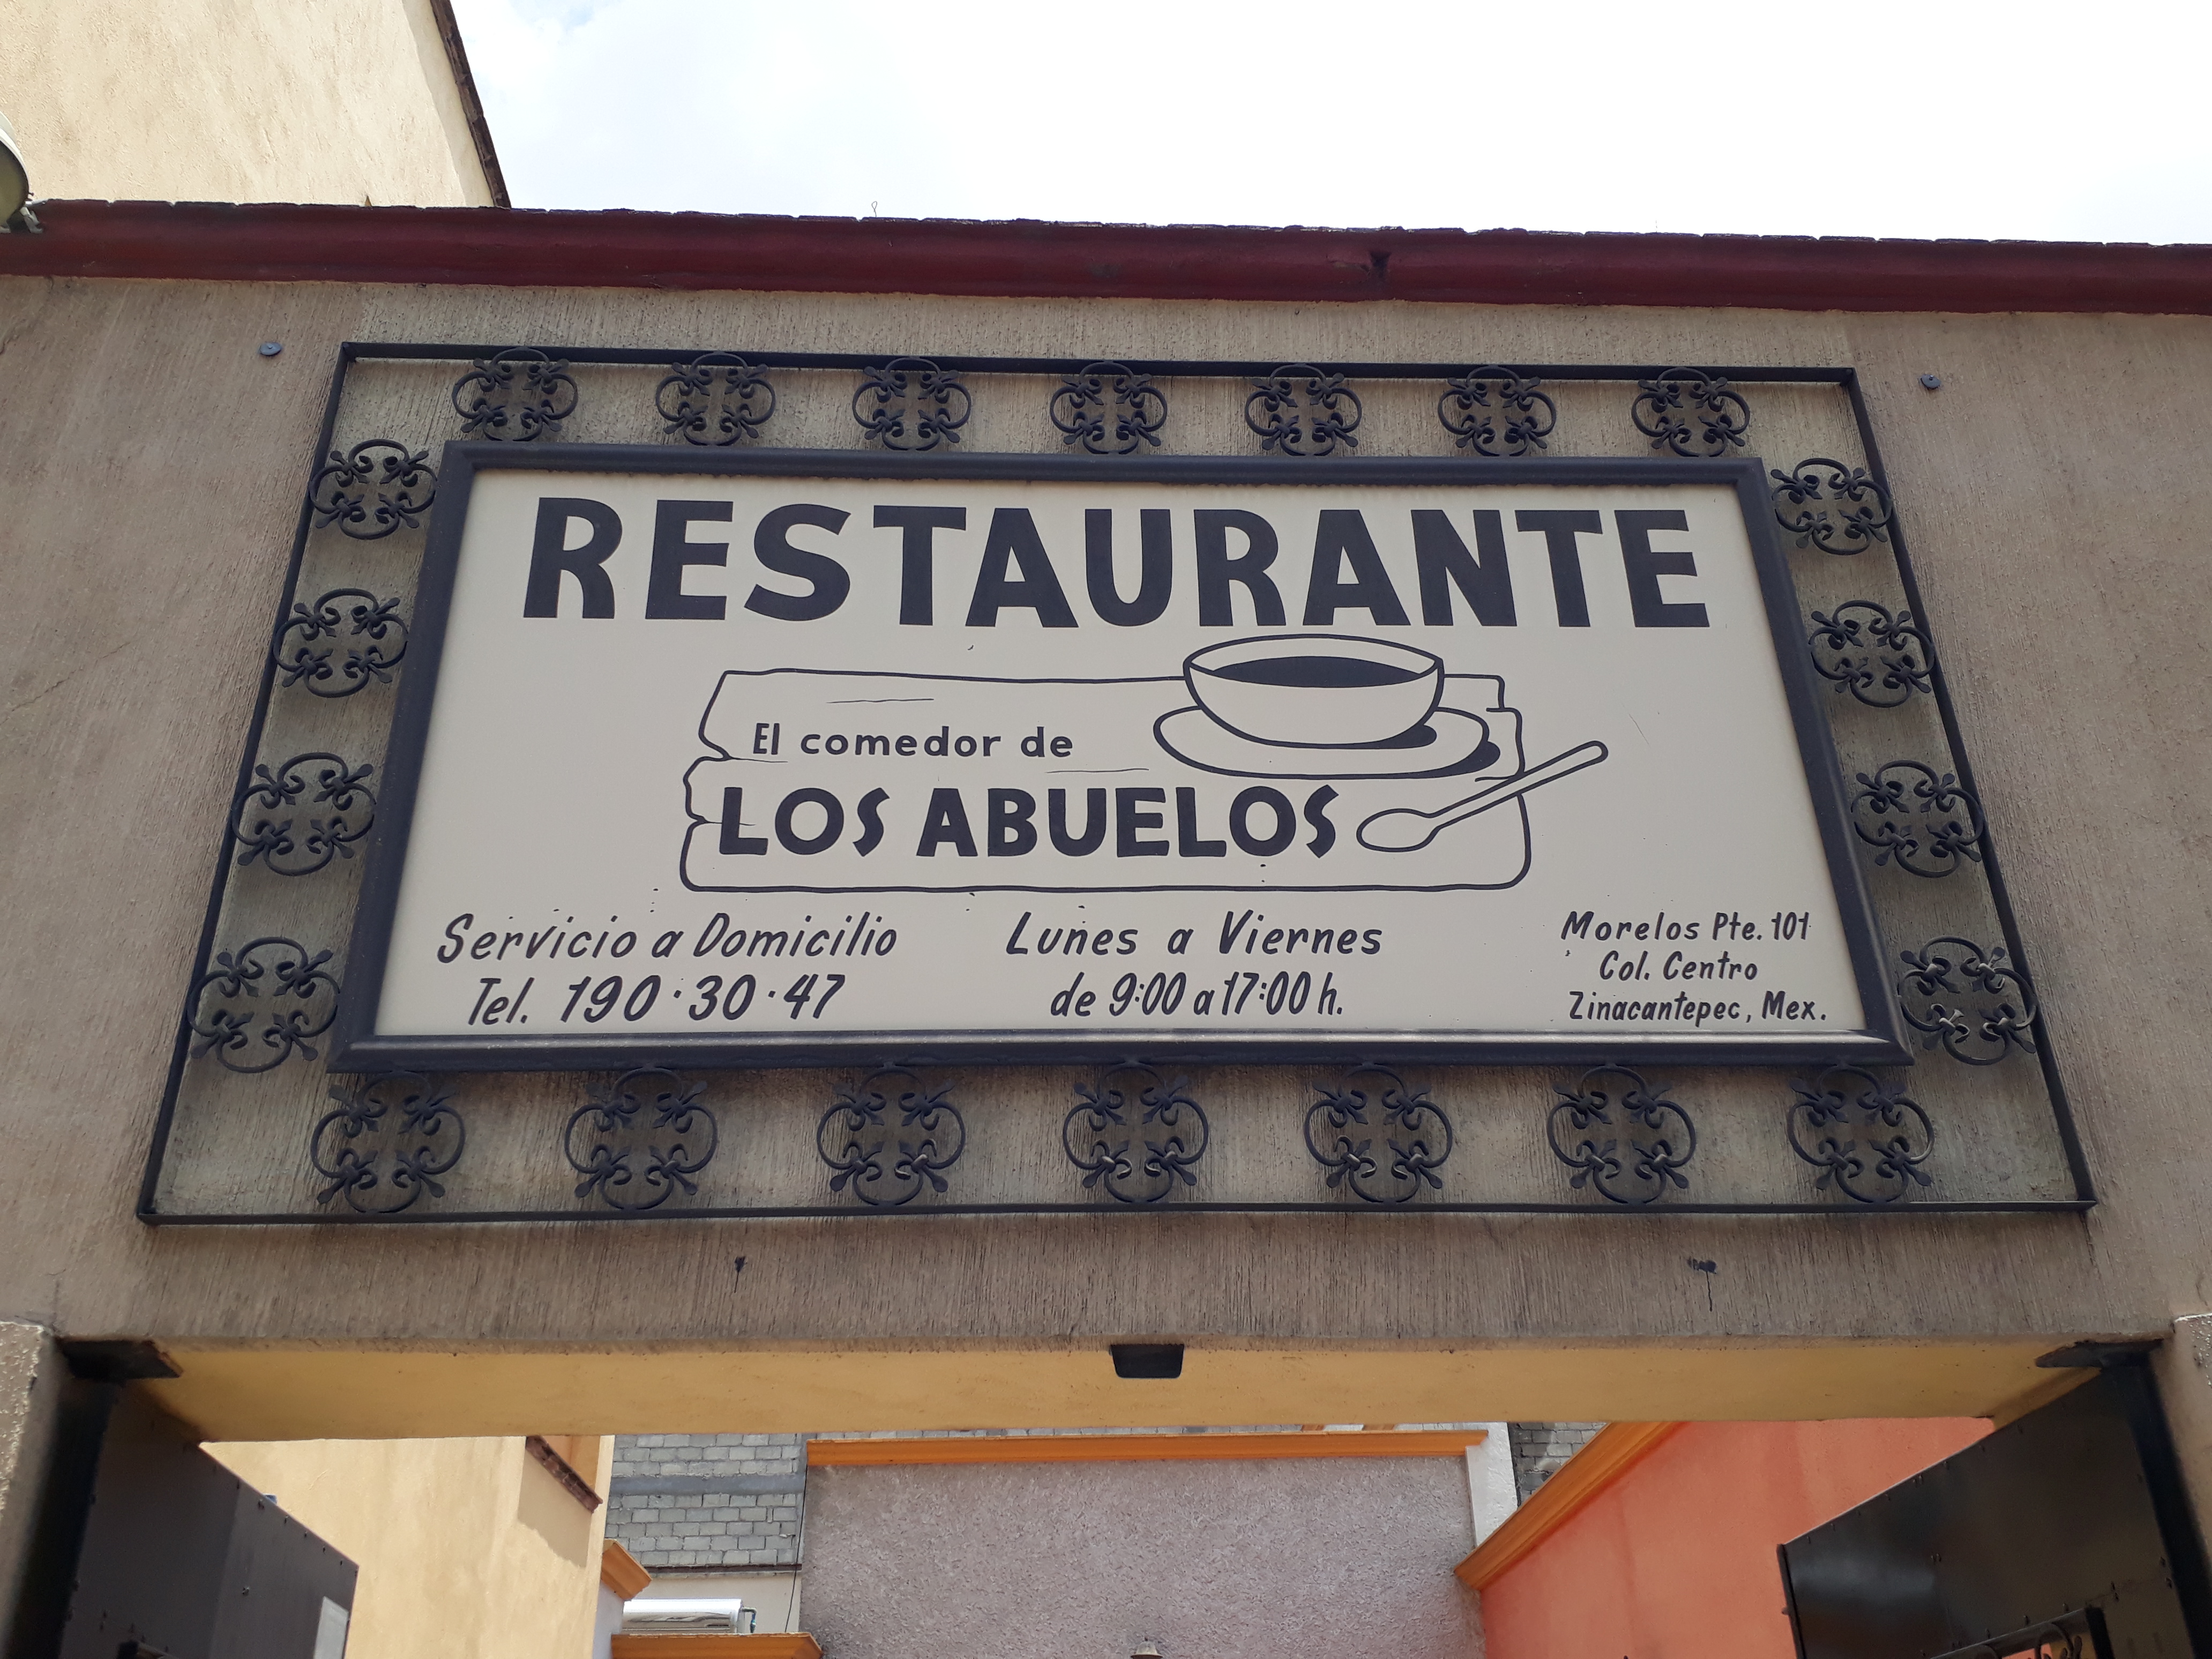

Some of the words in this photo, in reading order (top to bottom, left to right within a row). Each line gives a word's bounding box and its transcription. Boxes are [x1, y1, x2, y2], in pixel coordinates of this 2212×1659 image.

[524, 497, 1710, 627] RESTAURANTE
[753, 723, 780, 754] El
[801, 726, 1001, 757] comedor
[1021, 727, 1072, 757] de
[719, 787, 890, 857] LOS
[916, 784, 1339, 858] ABUELOS
[437, 914, 637, 963] Servicio
[652, 931, 684, 958] a
[693, 911, 896, 957] Domicilio
[1006, 912, 1138, 955] Lunes
[1168, 929, 1193, 954] a
[1220, 909, 1382, 954] Viernes
[1561, 911, 1699, 940] Morelos
[1713, 912, 1762, 940] Pte.
[1772, 912, 1809, 940] 101
[1600, 951, 1649, 981] Col.
[1663, 951, 1757, 980] Centro
[468, 978, 530, 1025] Tel.
[1051, 972, 1096, 1017] de
[1109, 972, 1186, 1016] 9:00
[1318, 972, 1342, 1015] h.
[1570, 991, 1751, 1027] Zinacantepec,
[1762, 991, 1826, 1020] Mex.
